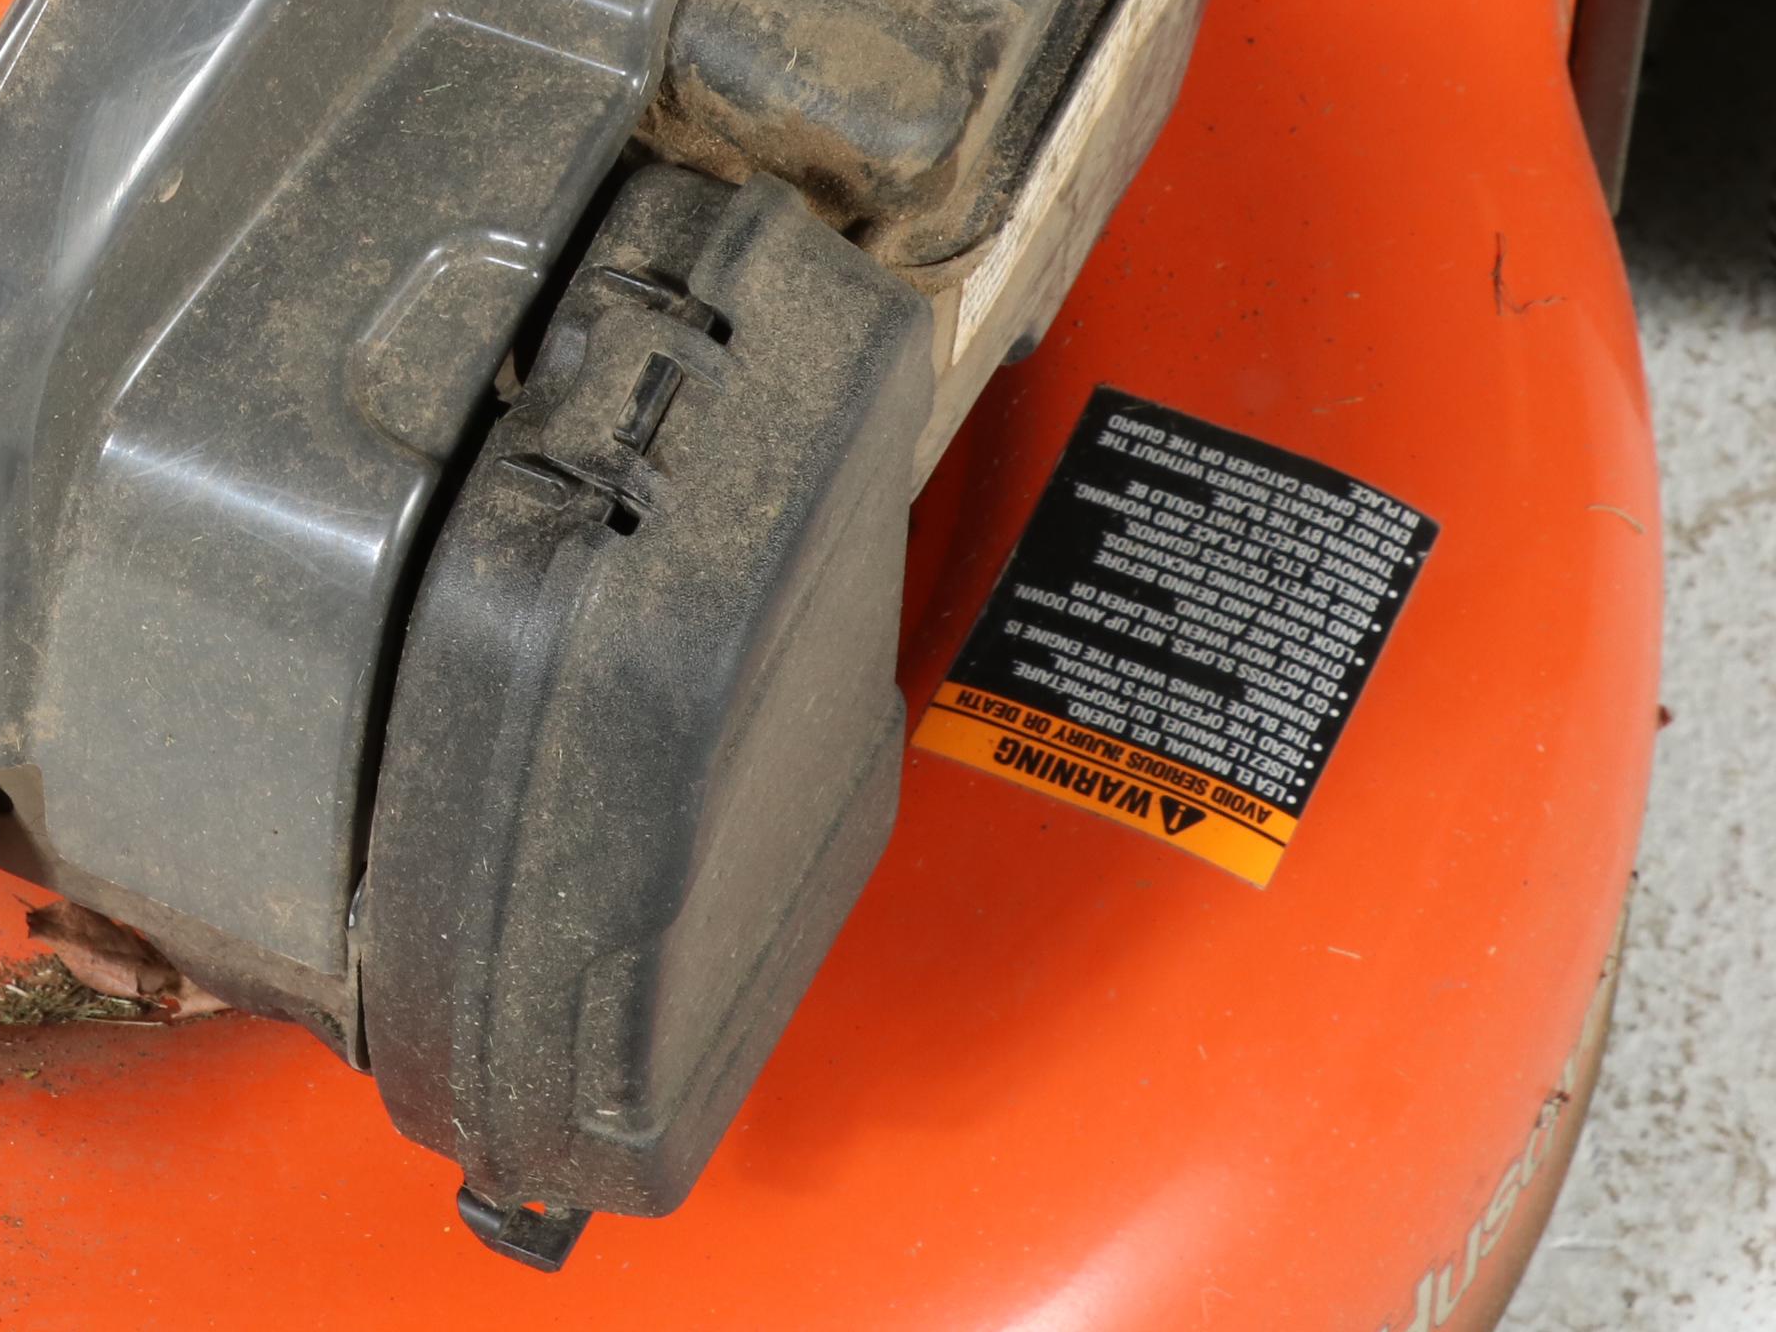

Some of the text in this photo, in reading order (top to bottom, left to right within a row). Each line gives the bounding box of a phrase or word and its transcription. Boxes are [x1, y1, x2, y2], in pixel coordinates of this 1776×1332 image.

[1109, 416, 1411, 544] ENTIRE GRASS CATCHER OR THE GUARD
[1099, 432, 1404, 561] DO NOT OPERATE MOWER WITHOUT THE
[1154, 512, 1189, 532] AND
[1268, 512, 1296, 533] THE
[1401, 511, 1419, 528] IN
[1127, 482, 1388, 595] REMOVE OBJECTS THAT COULD BE
[1190, 525, 1242, 552] PLACE
[1300, 527, 1323, 543] BY
[1243, 544, 1261, 559] IN
[1324, 536, 1393, 578] THROWN
[1202, 549, 1268, 583] DEVICES
[1207, 571, 1273, 605] MOVING
[1269, 577, 1330, 608] SAFETY
[1069, 602, 1105, 622] AND
[1095, 551, 1354, 662] LOOK DOWN AND BEHIND BEFORE
[1274, 597, 1325, 628] WHILE
[1330, 604, 1371, 628] KEEP
[1104, 617, 1129, 632] UP
[1130, 625, 1165, 646] NOT
[1246, 627, 1281, 648] ARE
[1328, 621, 1363, 644] AND
[1071, 583, 1337, 696] DO NOT MOW WHEN CHILDREN OR
[1282, 642, 1344, 679] OTHERS
[1005, 621, 1310, 748] THE BLADE TURNS WHEN THE ENGINE IS
[1238, 664, 1304, 700] ACROSS
[1130, 706, 1156, 724] DU
[1304, 694, 1328, 713] GO
[1132, 725, 1160, 746] DEL
[1162, 716, 1227, 751] MANUEL
[1226, 722, 1256, 744] THE
[956, 690, 1271, 823] AVOID SERIOUS INJURY OR DEATH
[1166, 737, 1232, 774] MANUAL
[1228, 743, 1249, 761] LE
[1260, 736, 1303, 766] READ
[994, 738, 1152, 817] WARNING
[1237, 766, 1254, 785] EL
[1249, 753, 1295, 783] LISEZ
[1256, 776, 1286, 801] LEA
